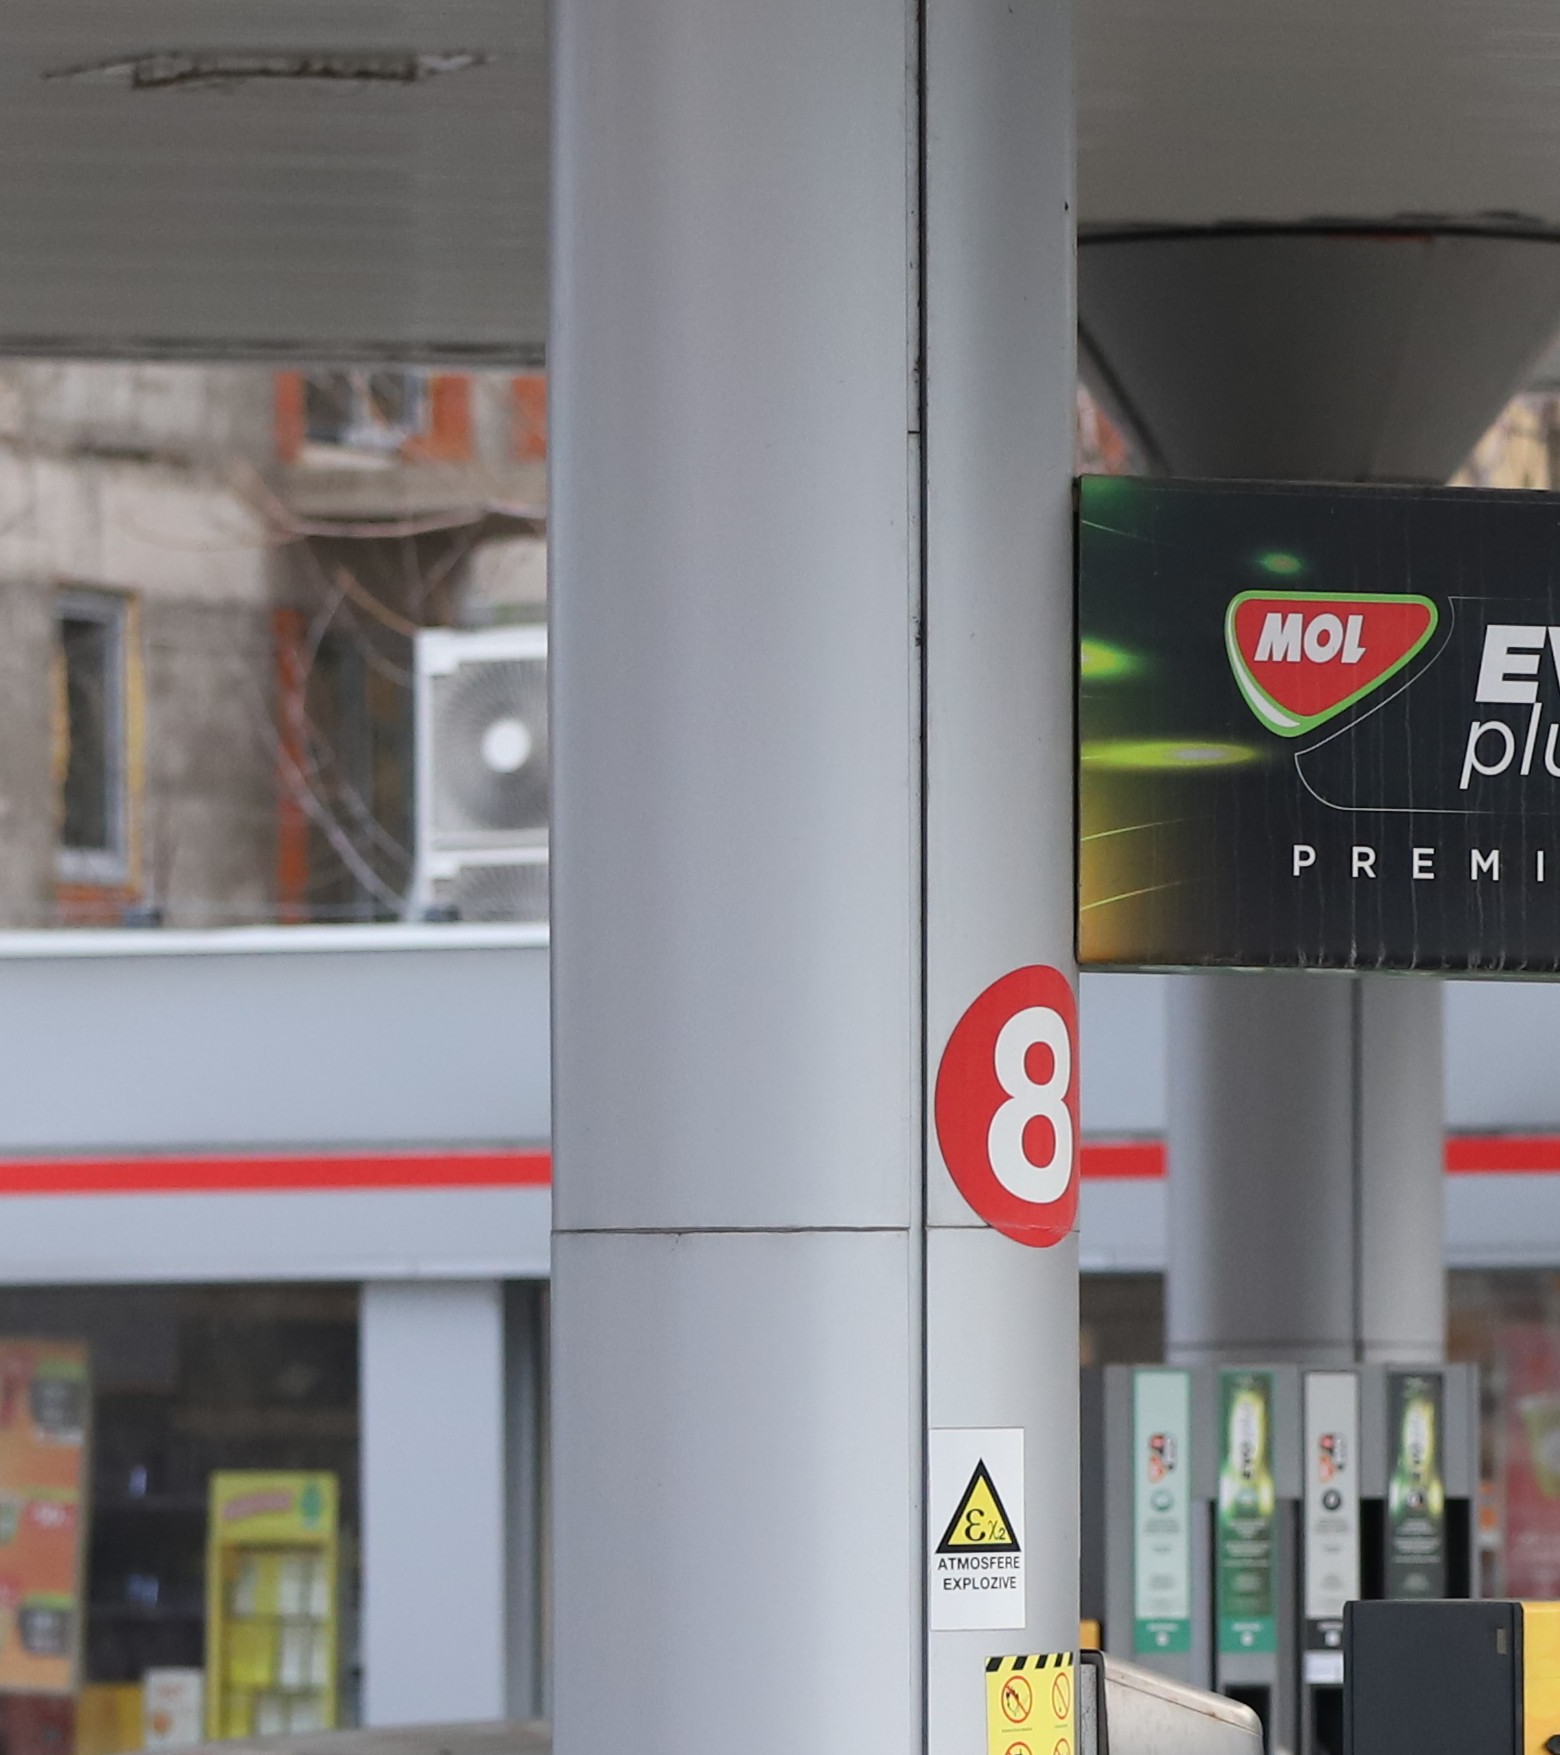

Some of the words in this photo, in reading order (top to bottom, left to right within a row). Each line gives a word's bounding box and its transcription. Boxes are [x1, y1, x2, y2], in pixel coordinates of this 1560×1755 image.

[1254, 611, 1366, 664] MOL
[988, 1005, 1074, 1204] 8
[938, 1555, 1021, 1571] ATMOSFERE
[943, 1576, 1017, 1591] EXPLOZIVE
